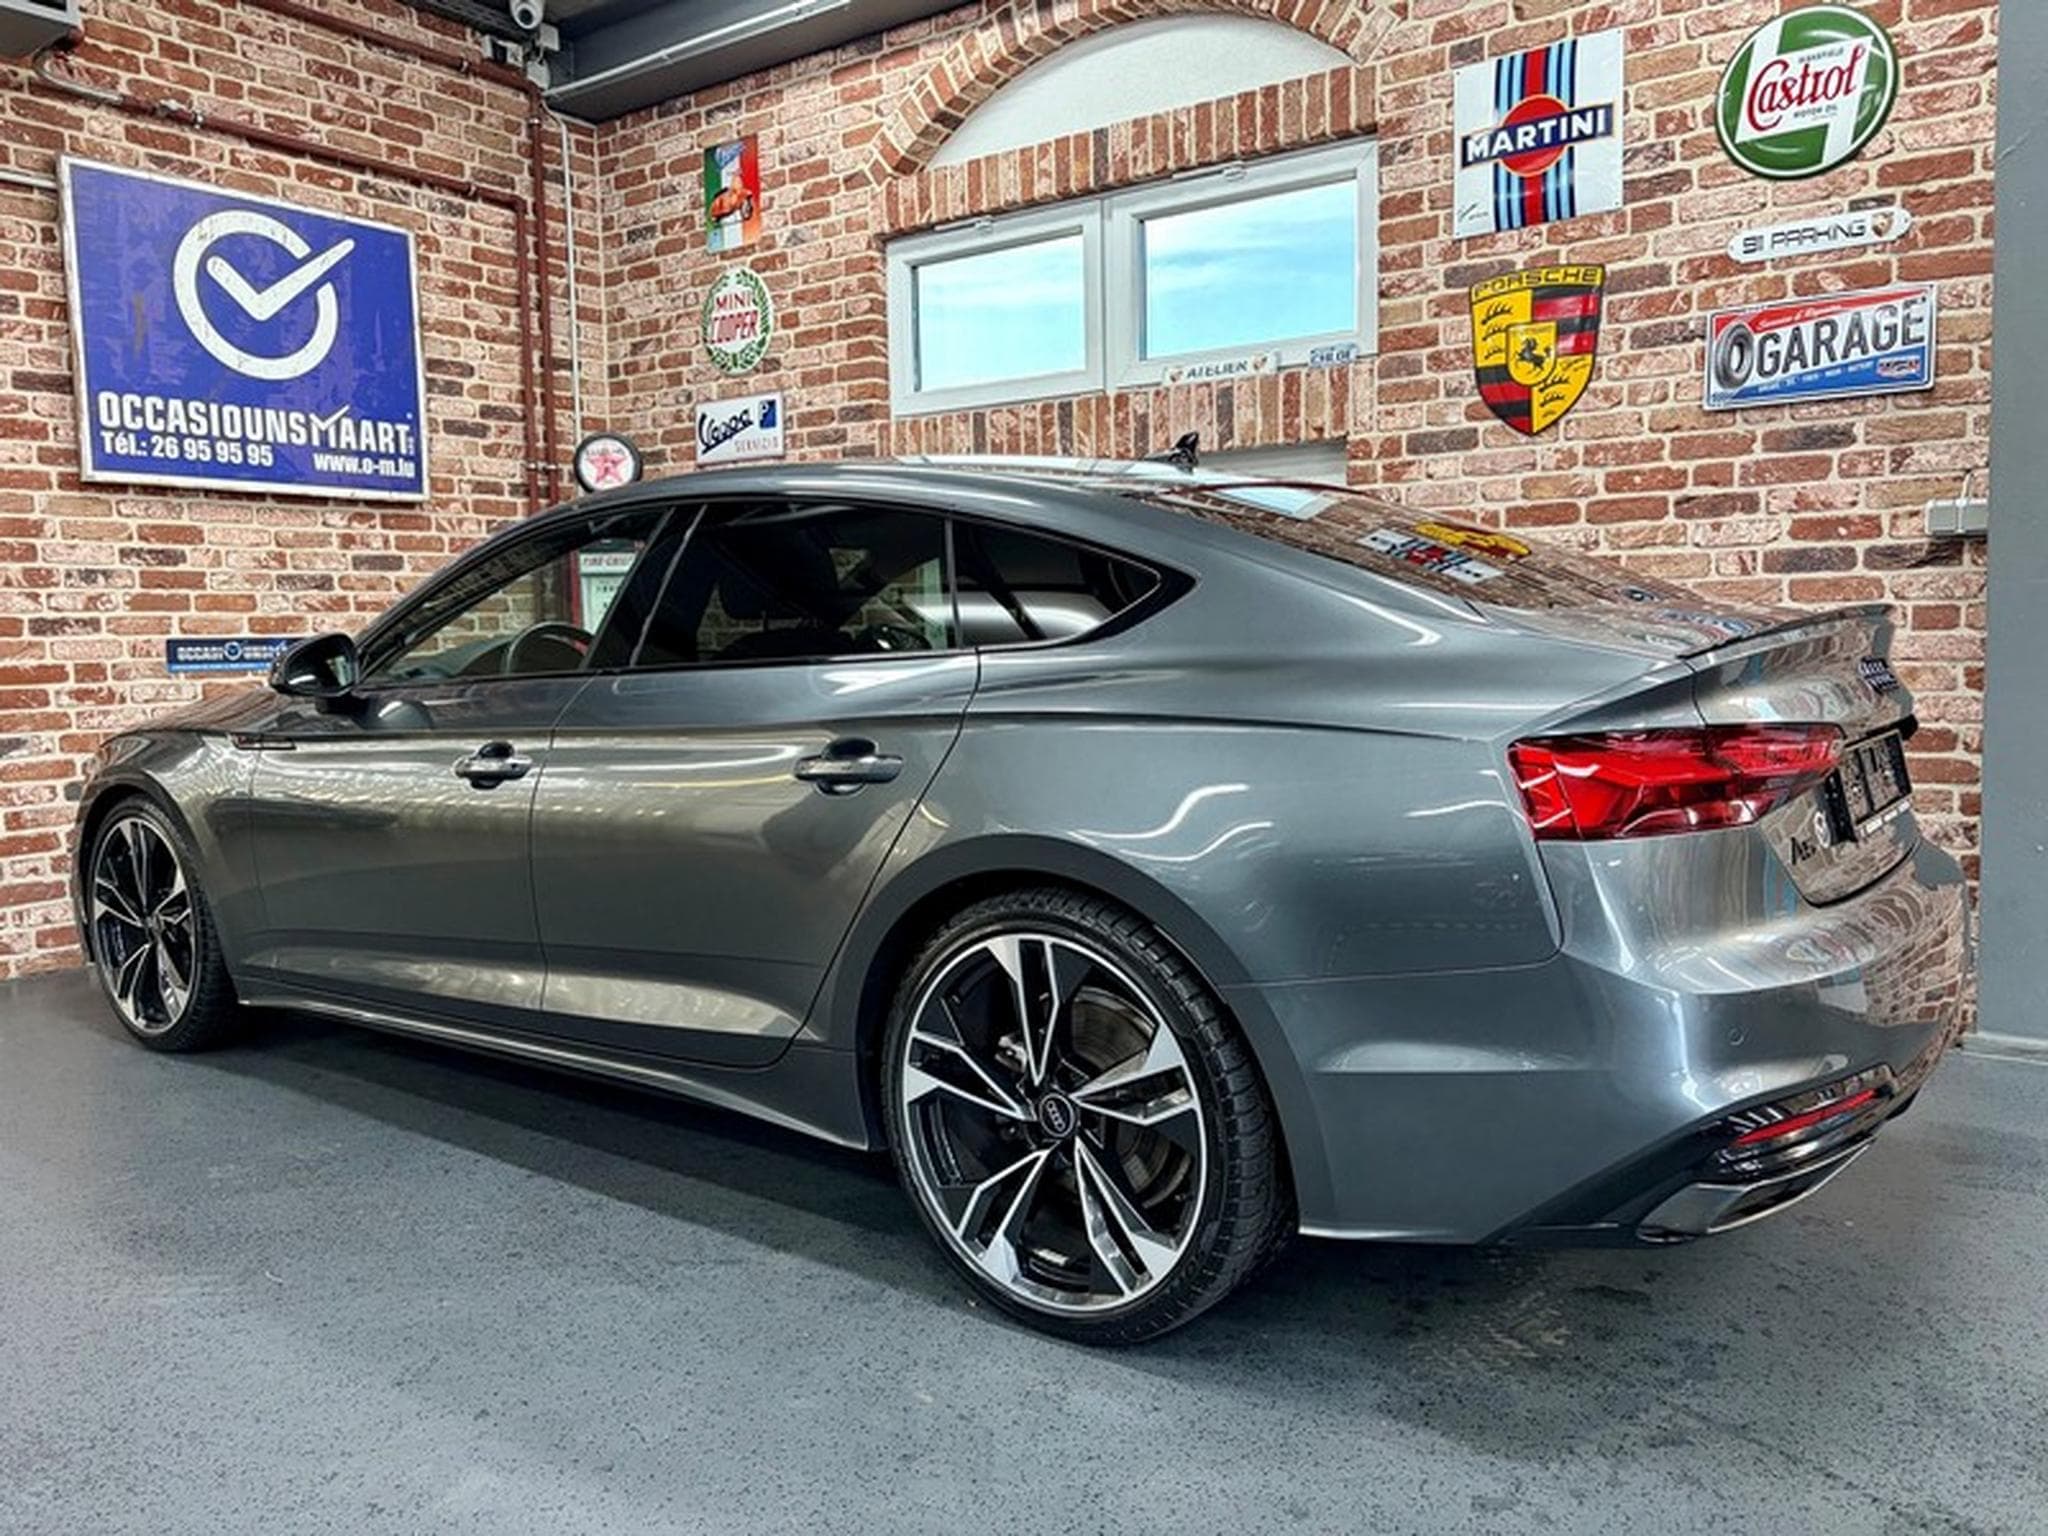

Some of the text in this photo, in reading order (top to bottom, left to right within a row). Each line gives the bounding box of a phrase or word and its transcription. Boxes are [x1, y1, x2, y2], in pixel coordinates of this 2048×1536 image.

[1747, 43, 1867, 132] Castrol
[1466, 108, 1606, 162] MARTINI
[1771, 219, 1867, 249] PARKING
[1474, 268, 1598, 298] PORSCHE
[716, 291, 752, 310] MINI
[1756, 298, 1926, 378] GARAGE
[151, 436, 180, 459] 26
[183, 439, 211, 462] 95
[215, 441, 243, 464] 95
[247, 444, 275, 467] 95
